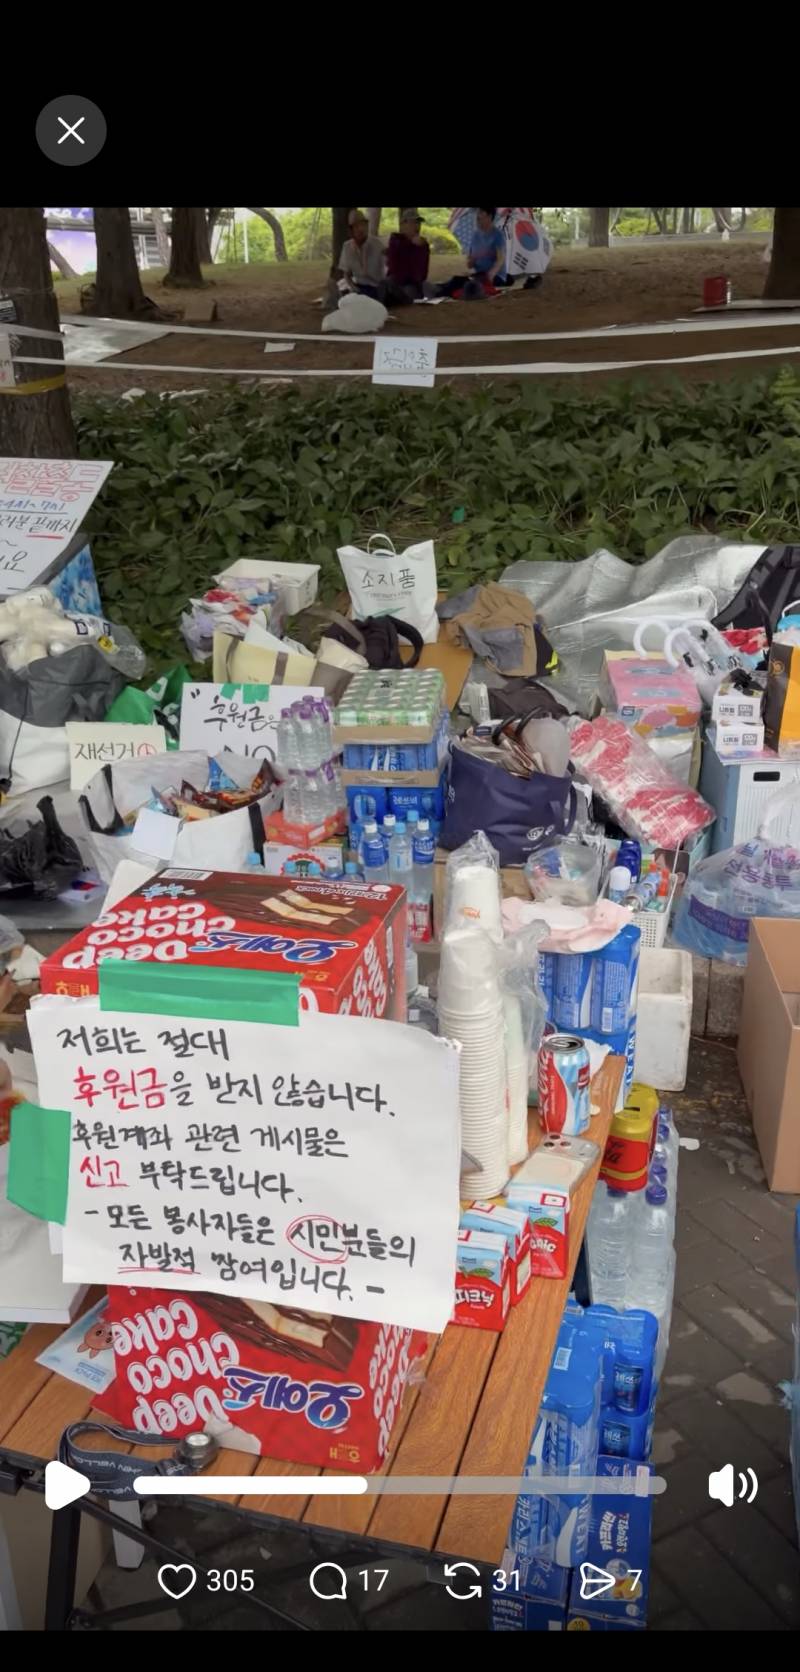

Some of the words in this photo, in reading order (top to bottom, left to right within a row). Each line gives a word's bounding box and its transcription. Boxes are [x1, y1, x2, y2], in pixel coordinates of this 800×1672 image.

[361, 568, 416, 590] 소지품
[203, 696, 281, 733] 후원금은
[63, 939, 188, 970] Deep
[188, 931, 359, 964] 오예스
[56, 1026, 146, 1057] 저희는
[158, 1027, 230, 1061] 절대
[73, 1066, 194, 1110] 후원금을
[206, 1072, 263, 1106] 받지
[271, 1073, 396, 1117] 않습니다.
[72, 1119, 174, 1152] 후원계좌
[184, 1123, 240, 1153] 관련
[250, 1125, 349, 1158] 게시물은
[80, 1155, 130, 1188] 신고
[139, 1159, 304, 1203] 부탁드립니다.
[107, 1204, 153, 1231] 모든
[163, 1204, 276, 1247] 봉사자들은
[289, 1218, 416, 1268] 시민분들의
[118, 1241, 196, 1273] 자발적
[210, 1251, 355, 1302] 참여입니다.
[132, 1385, 230, 1435] Deep
[222, 1364, 365, 1430] 오예스
